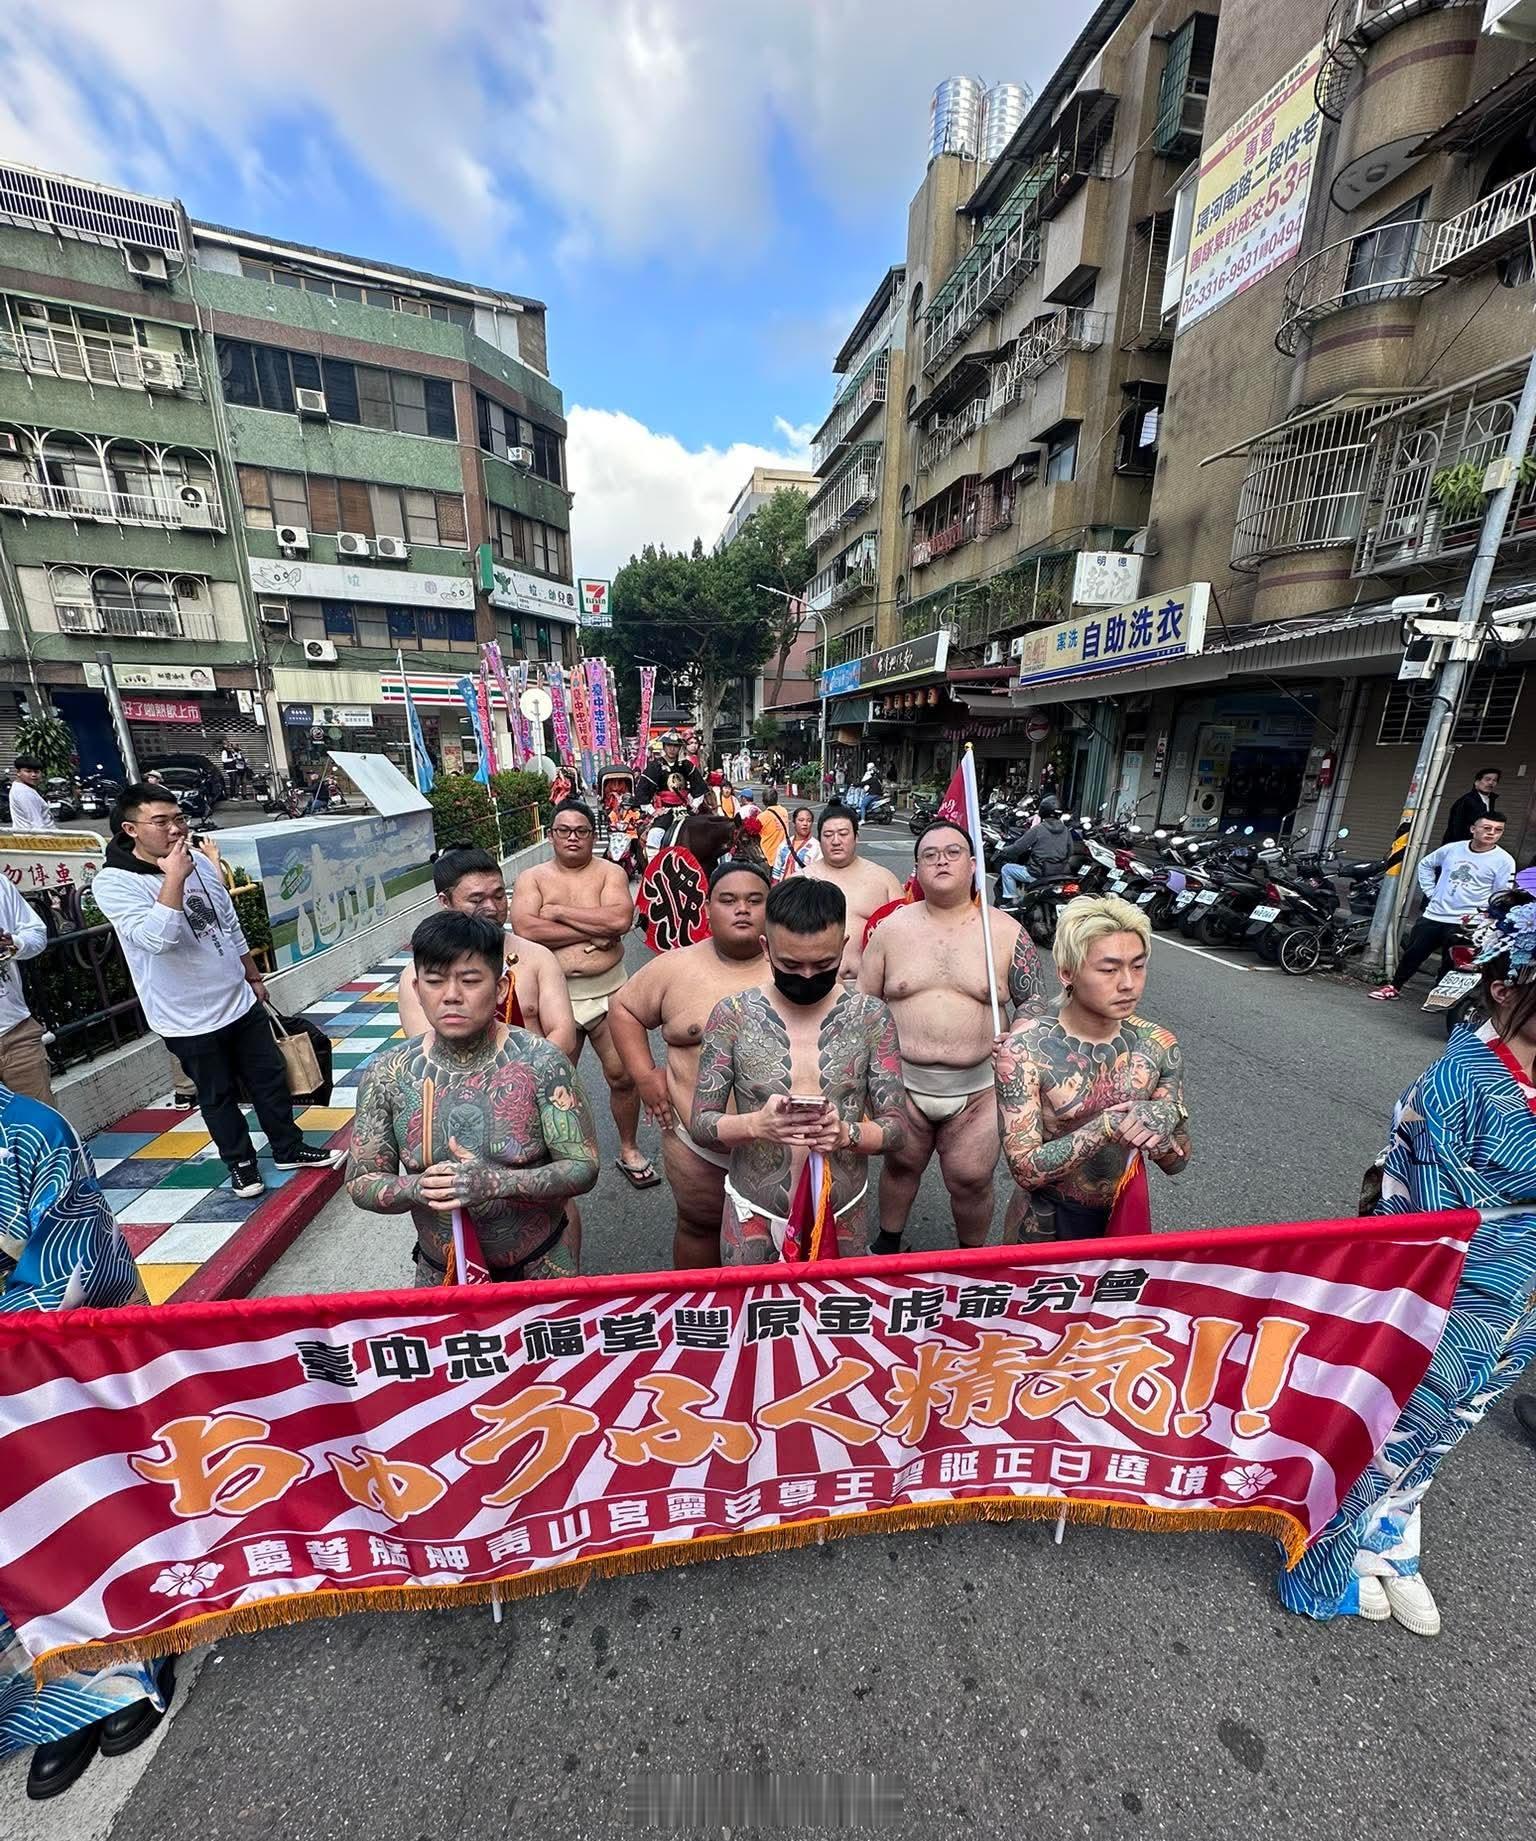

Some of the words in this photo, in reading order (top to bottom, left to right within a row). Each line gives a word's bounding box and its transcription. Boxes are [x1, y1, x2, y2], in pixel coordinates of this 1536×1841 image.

[1195, 110, 1321, 237] 環河南路二段住宅
[1243, 117, 1276, 166] 專營
[1190, 156, 1312, 275] 團隊累計成交53戶
[1056, 628, 1078, 651] 潔洗
[1082, 599, 1185, 661] 自助洗衣
[4, 862, 74, 886] 勿停車
[297, 1267, 1149, 1388] 臺中忠福堂豐原金虎爺分會
[130, 1317, 1308, 1522] ちゅうふく精気!!
